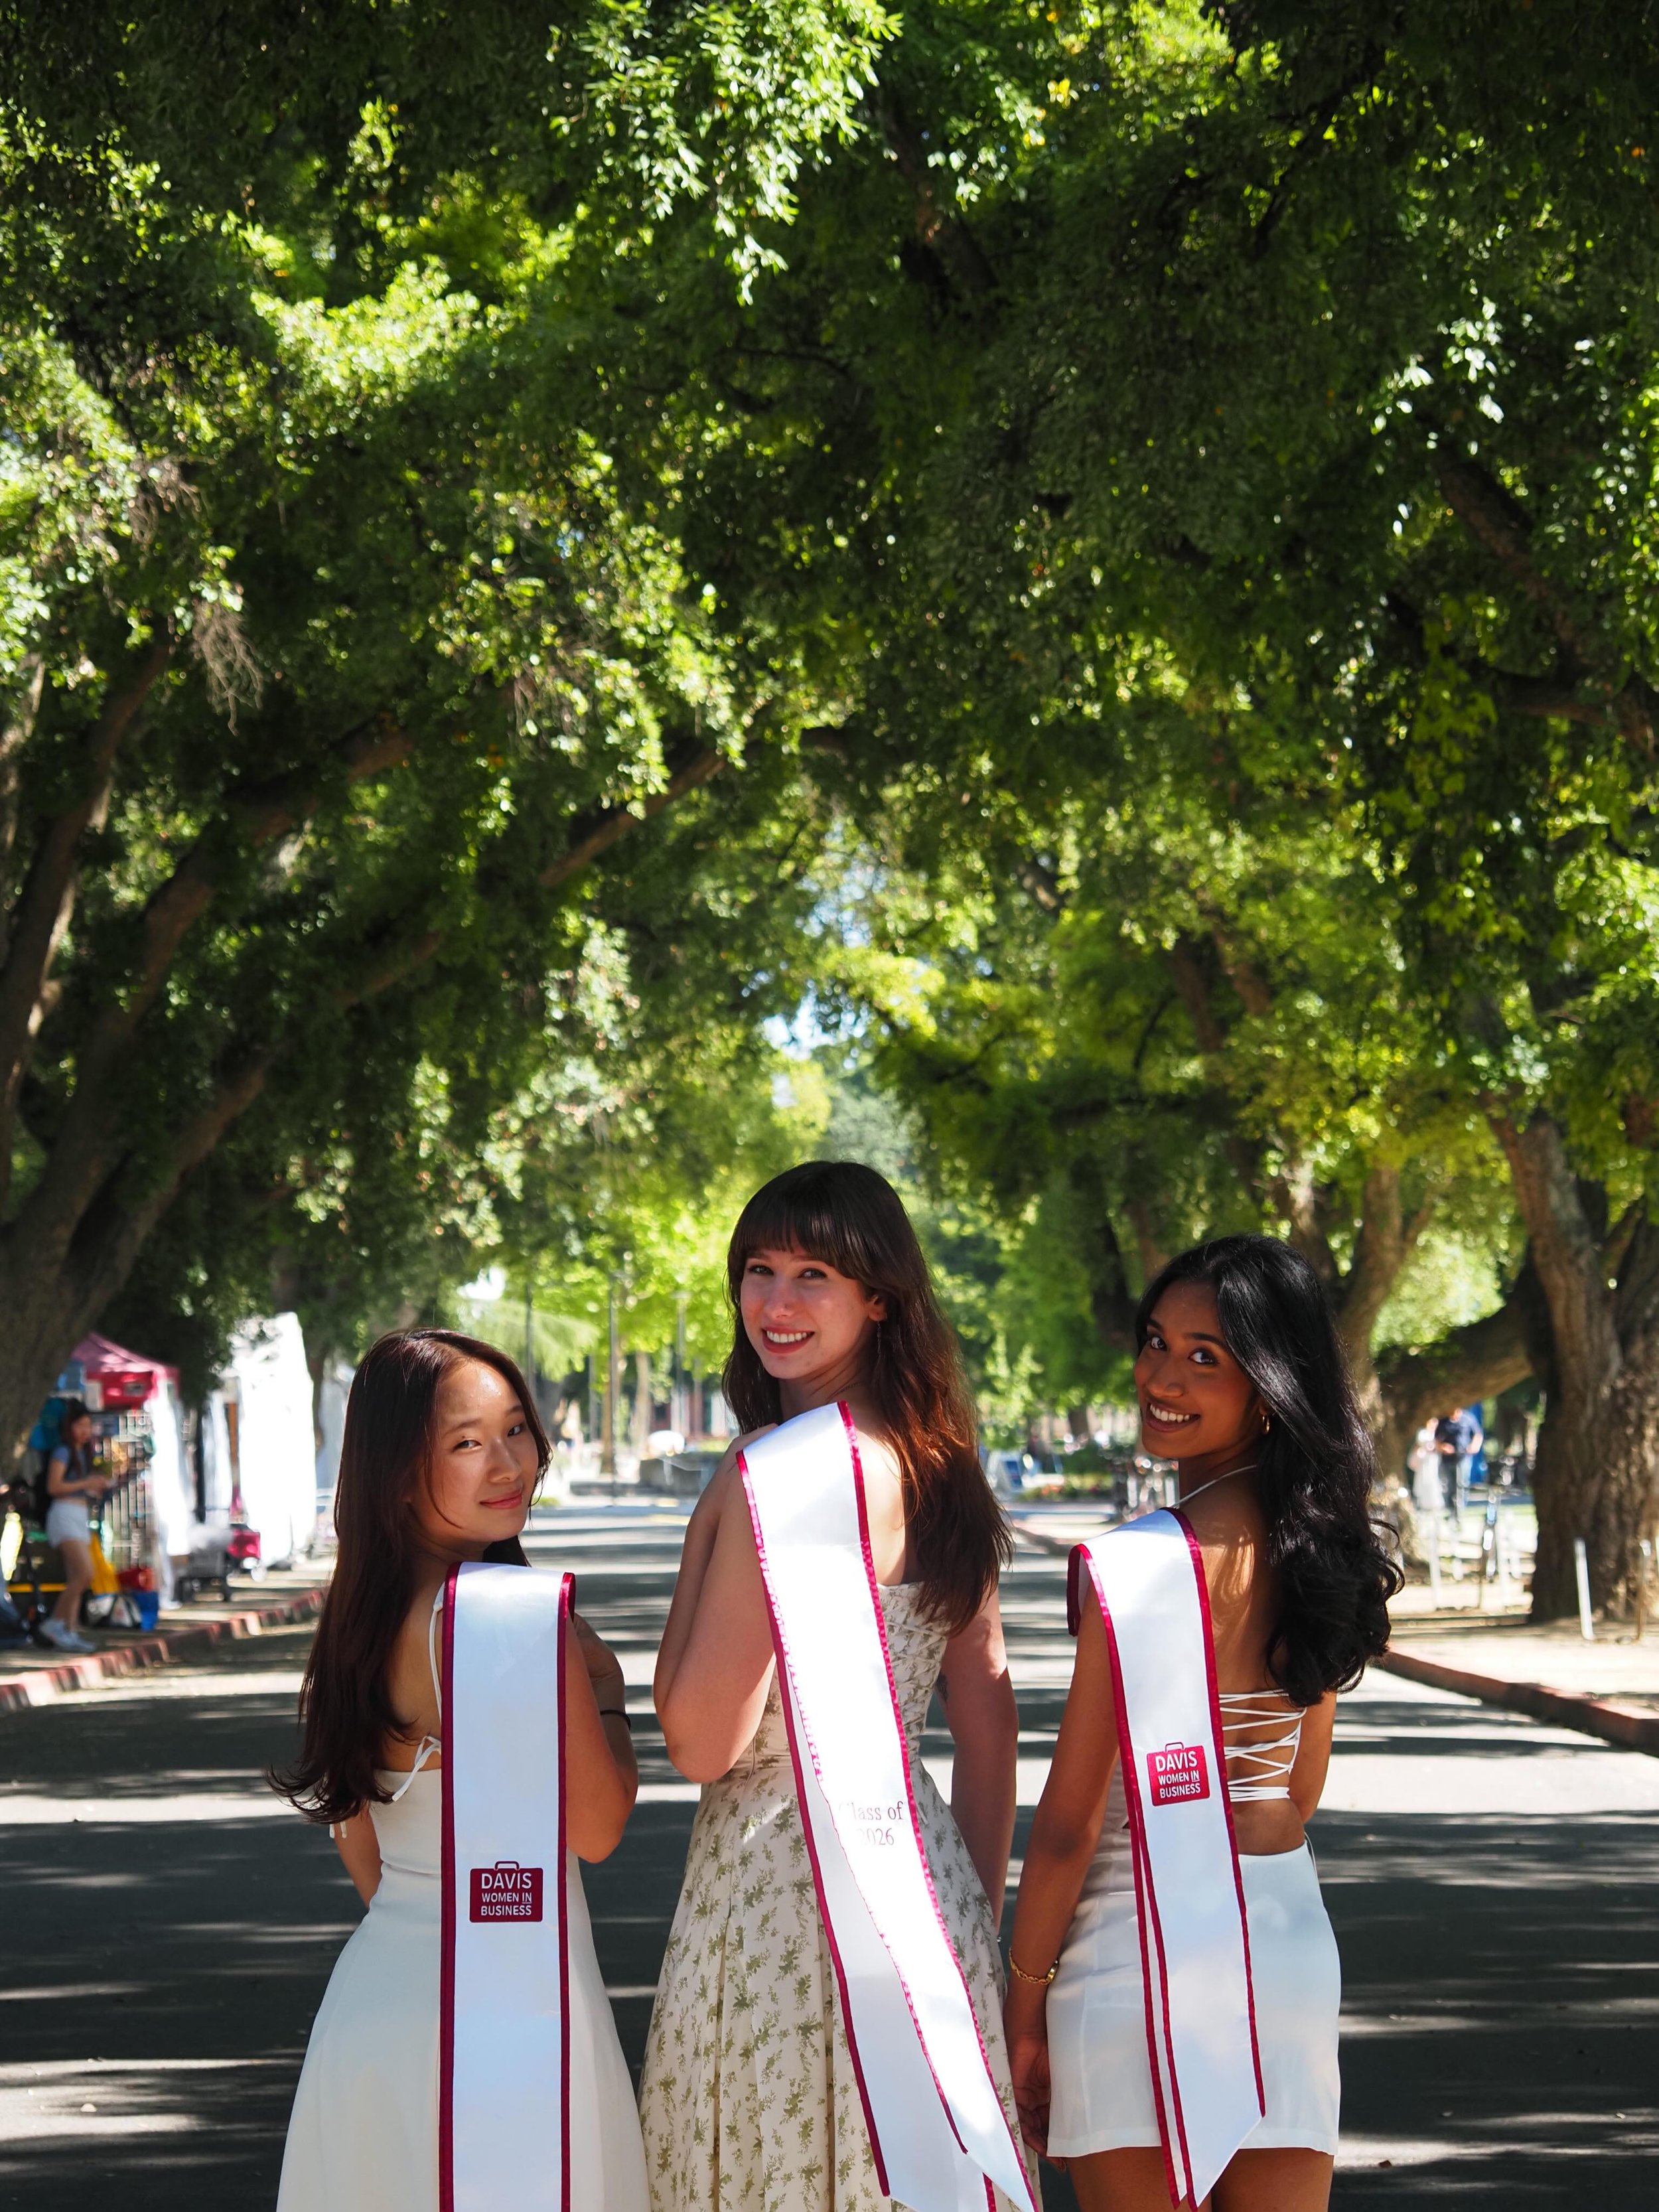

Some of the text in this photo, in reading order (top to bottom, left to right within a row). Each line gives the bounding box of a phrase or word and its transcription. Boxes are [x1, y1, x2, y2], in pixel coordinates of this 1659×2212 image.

[1155, 1751, 1197, 1773] DAVIS
[1158, 1769, 1200, 1786] WOMEN IN
[1159, 1783, 1200, 1799] BUSINESS
[887, 1801, 904, 1820] of
[481, 1873, 532, 1889] DAVIS
[482, 1892, 532, 1903] WOMEN IN
[481, 1905, 532, 1916] BUSINESS
